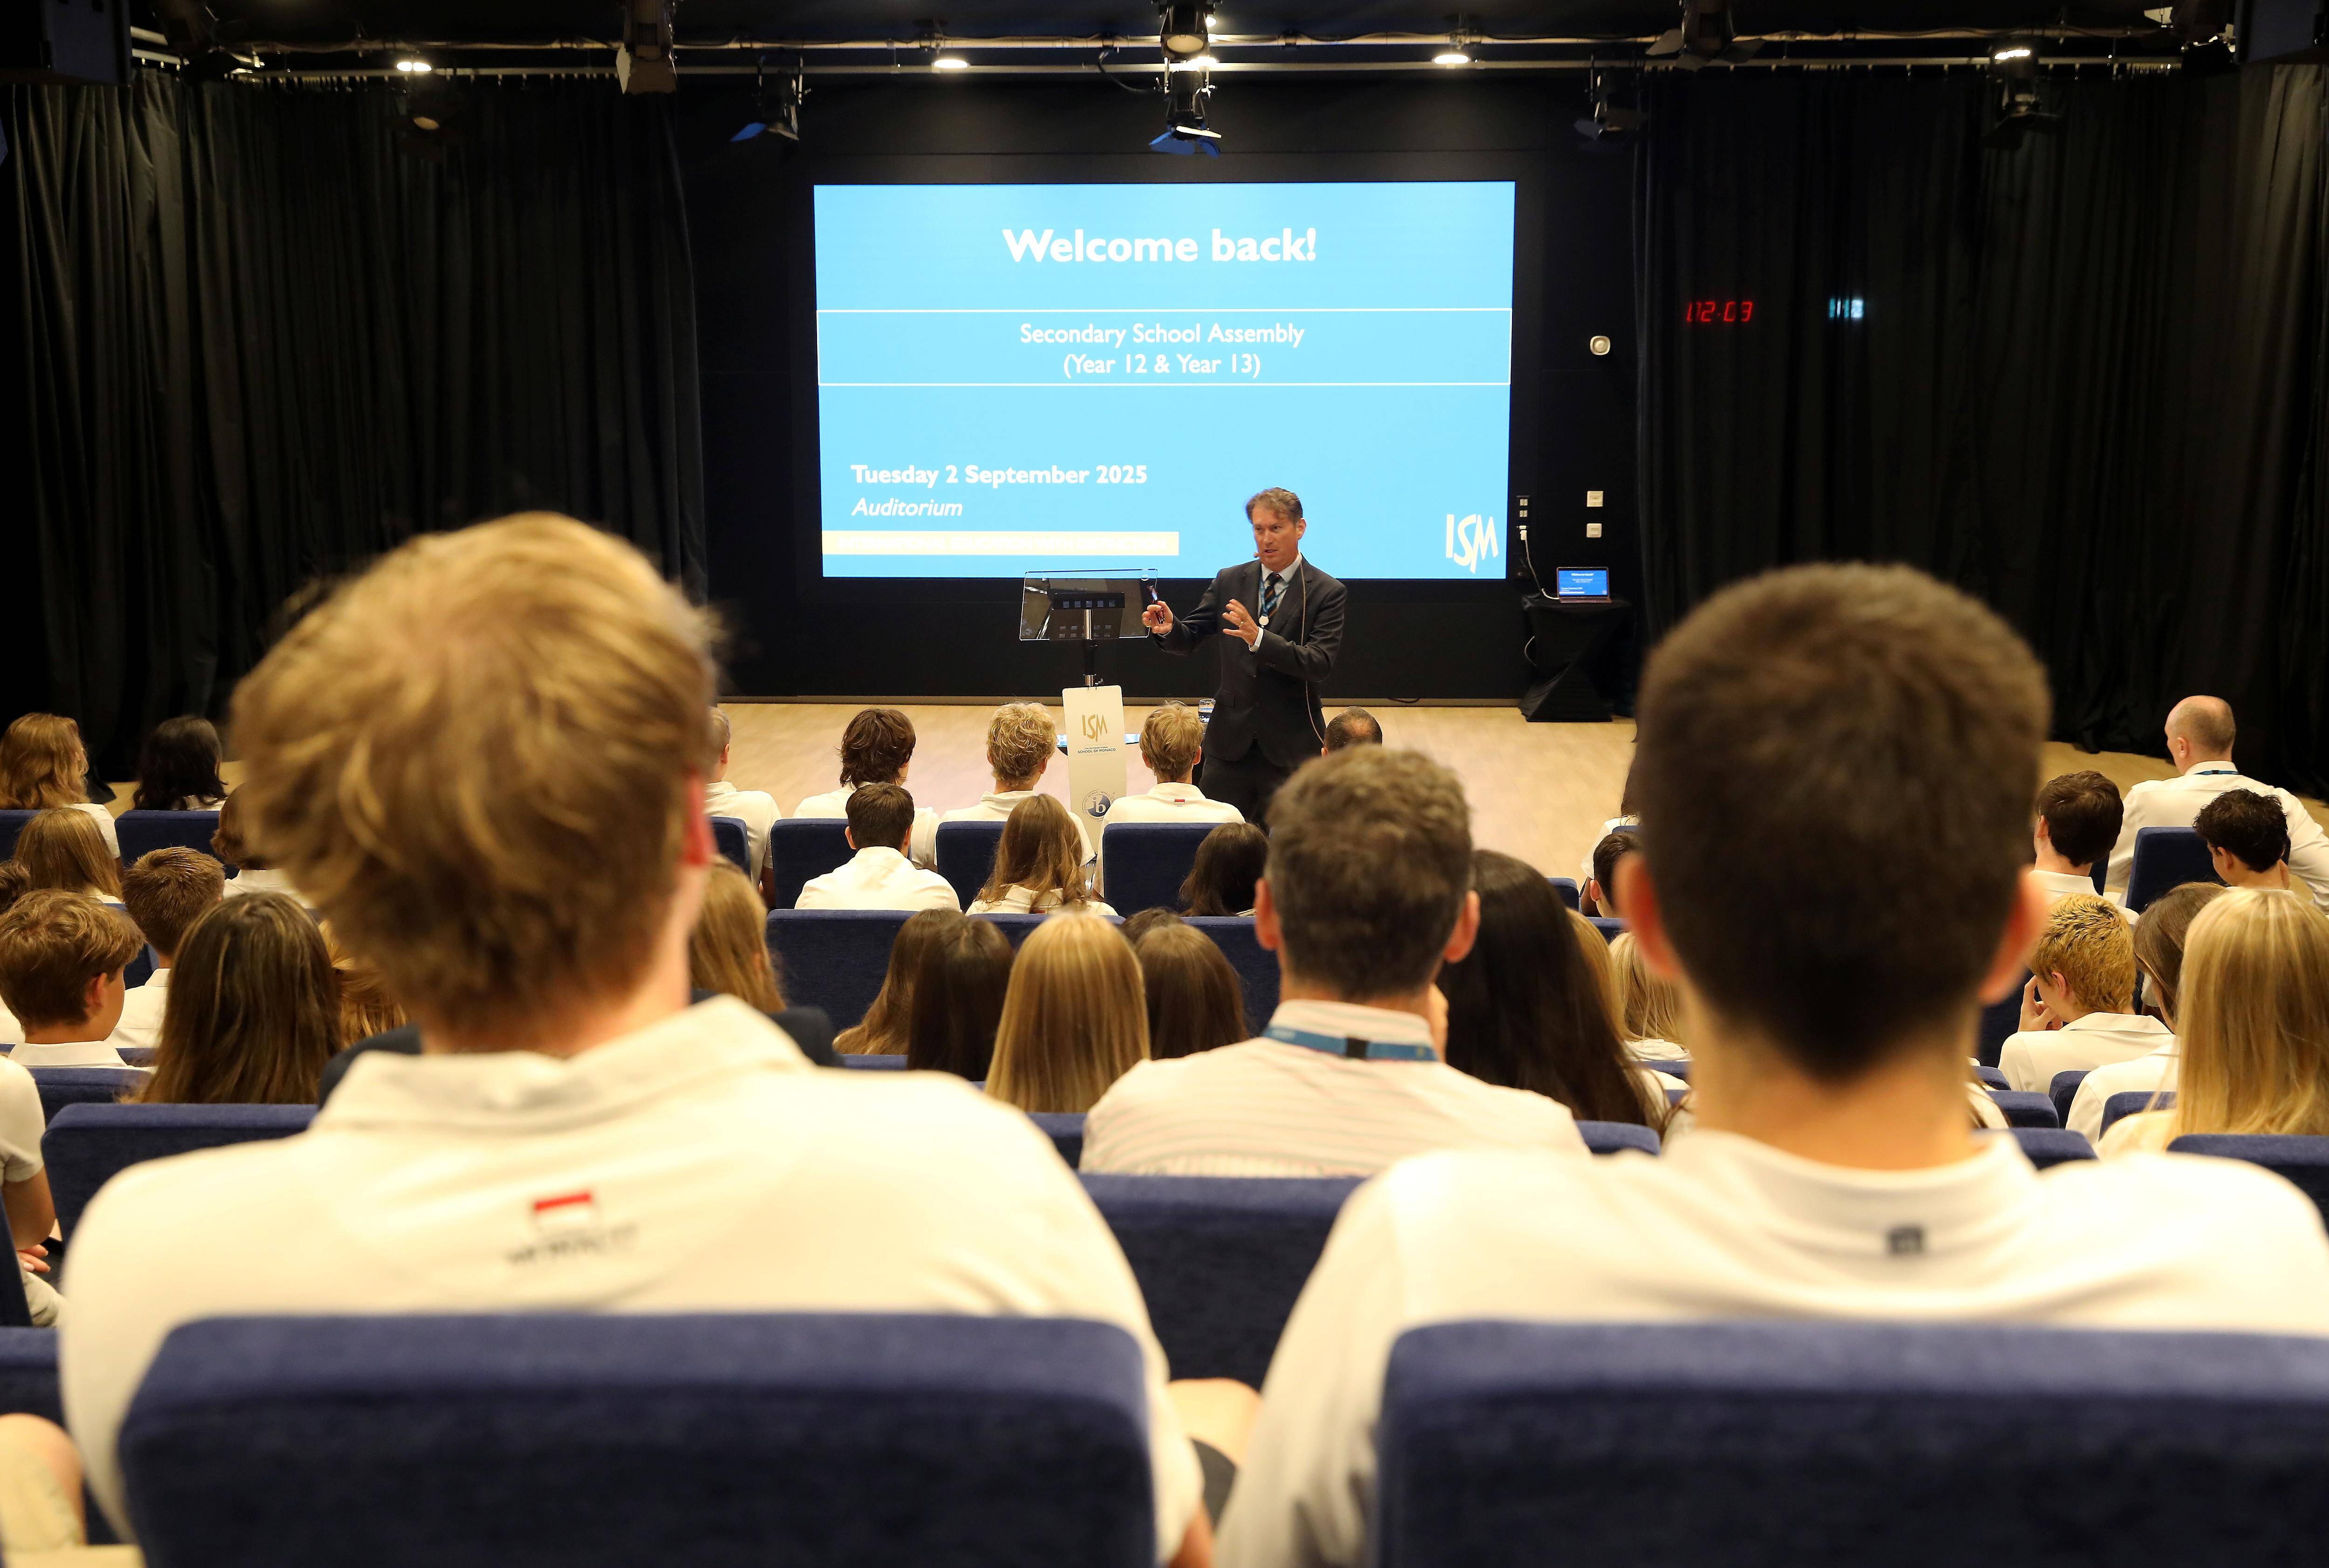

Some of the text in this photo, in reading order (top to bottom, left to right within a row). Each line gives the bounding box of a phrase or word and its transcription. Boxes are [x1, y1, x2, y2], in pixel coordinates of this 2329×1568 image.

[1002, 227, 1316, 263] Welcome back!
[1020, 323, 1305, 348] Secondary School Assembly
[1063, 353, 1261, 379] (Year 12 & Year 13)
[850, 464, 1147, 489] Tuesday 2 September 2025
[851, 497, 963, 516] Auditorium
[1445, 514, 1498, 574] ISM
[1082, 714, 1108, 743] ISM
